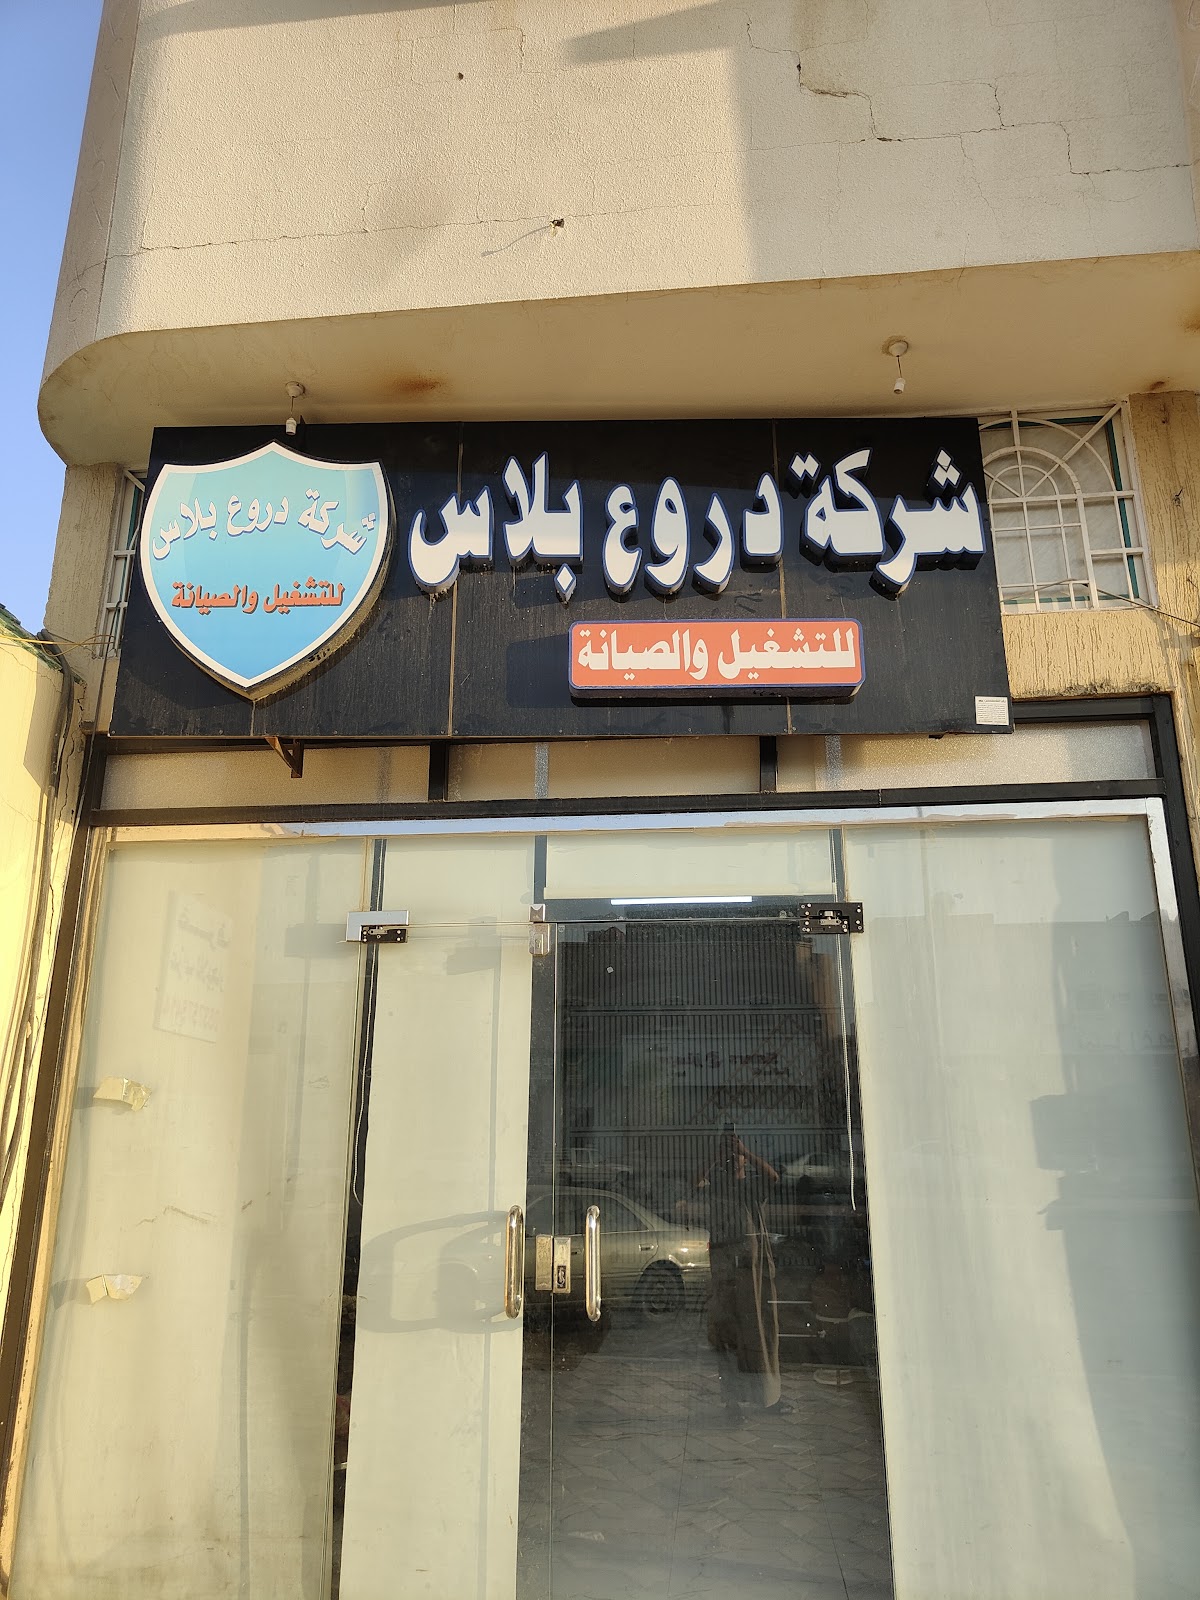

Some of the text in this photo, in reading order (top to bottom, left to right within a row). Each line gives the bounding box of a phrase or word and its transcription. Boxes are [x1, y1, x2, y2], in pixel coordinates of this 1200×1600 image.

[153, 488, 377, 559] شركة دروع بلاس
[409, 447, 986, 601] شركة دروع بلاس
[172, 576, 346, 615] للتشغيل والصيانة
[578, 628, 856, 681] للتشغيل والصيانة
